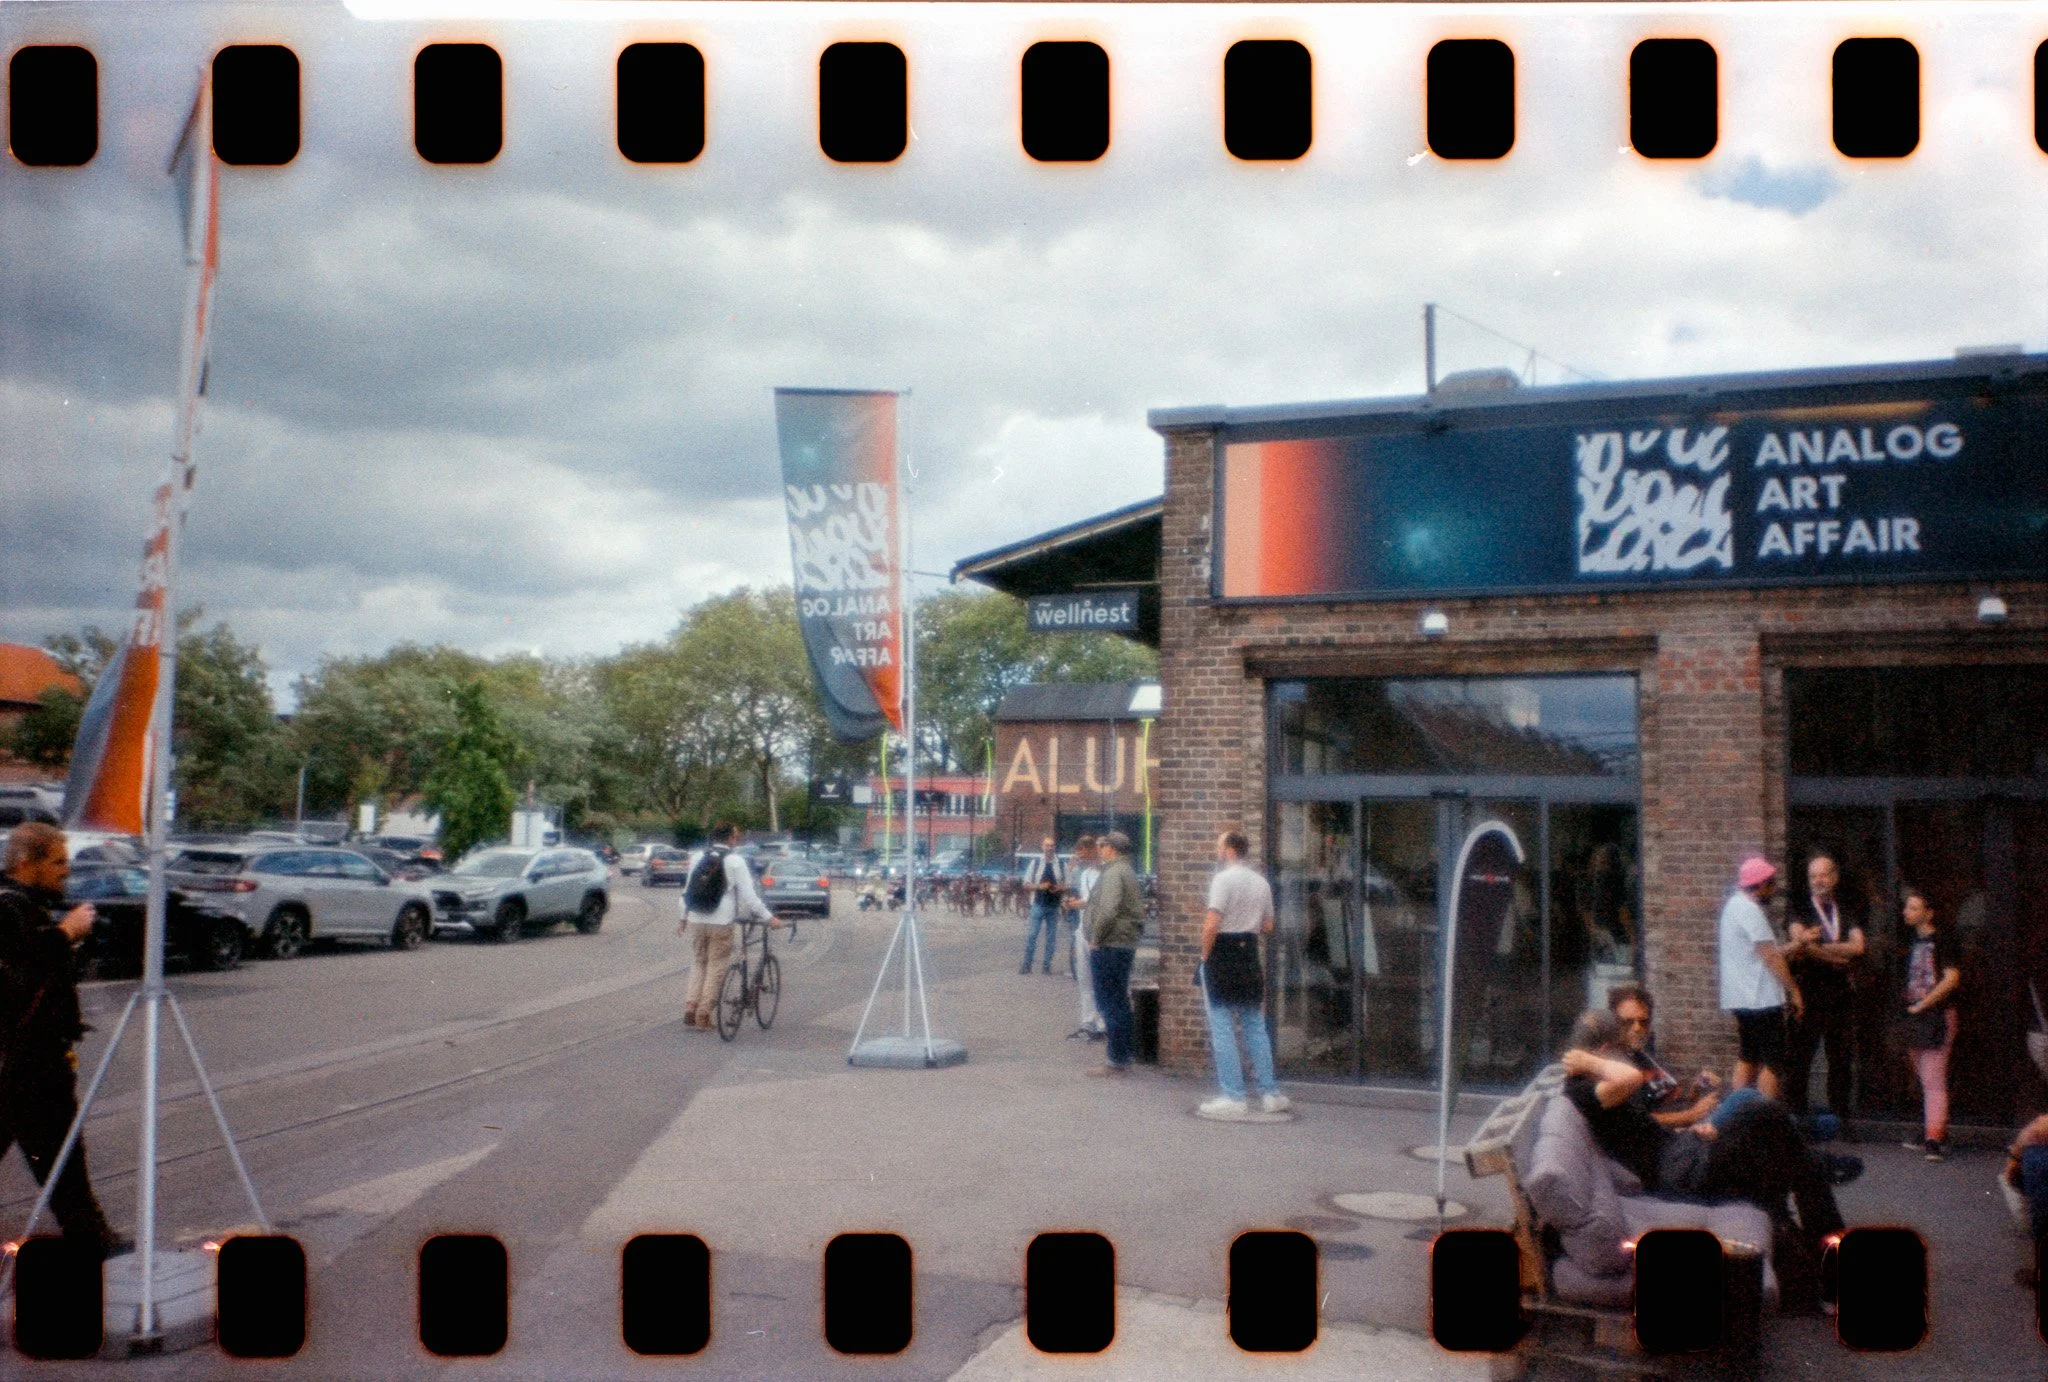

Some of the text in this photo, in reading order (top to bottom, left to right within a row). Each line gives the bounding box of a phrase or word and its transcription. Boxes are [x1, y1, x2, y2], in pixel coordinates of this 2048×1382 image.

[1754, 422, 1965, 467] ANALOG
[1756, 473, 1847, 513] ART
[1757, 517, 1921, 557] AFFAIR
